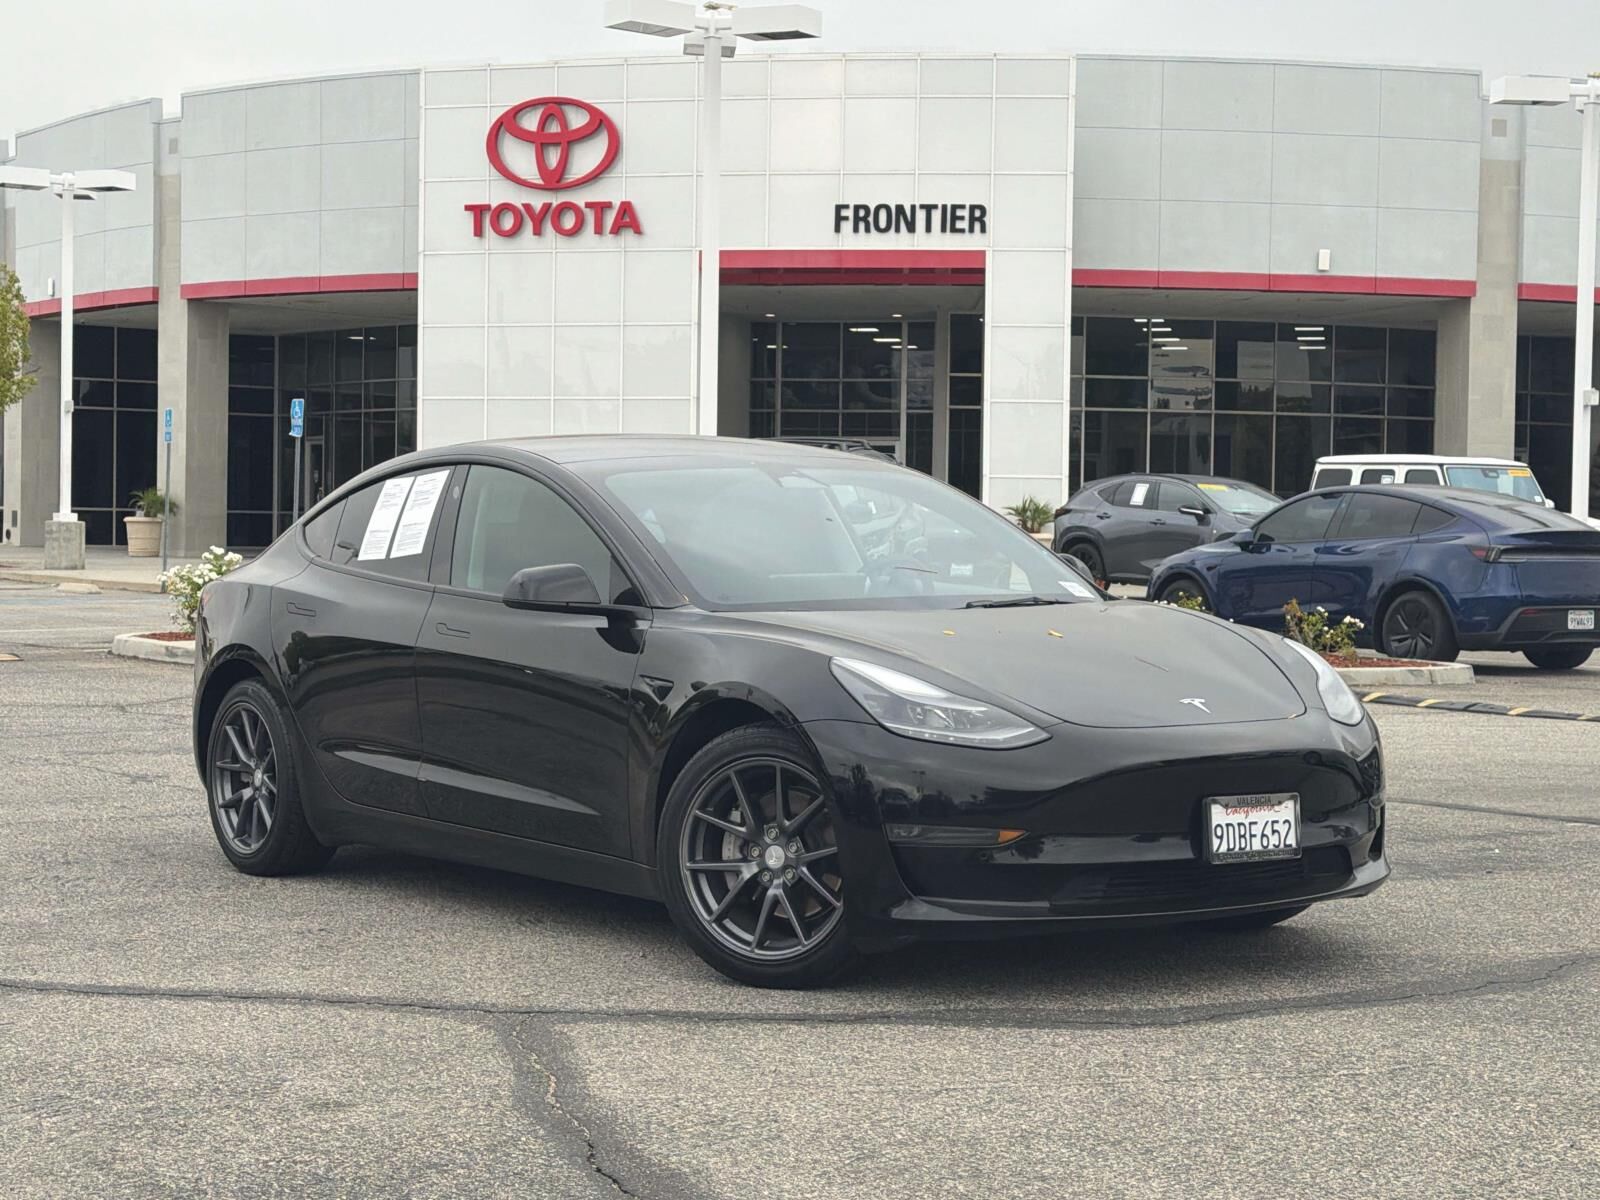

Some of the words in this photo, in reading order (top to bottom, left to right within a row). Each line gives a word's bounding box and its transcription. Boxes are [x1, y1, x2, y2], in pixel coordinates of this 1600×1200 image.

[464, 200, 642, 238] TOYOTA
[834, 203, 987, 234] FRONTIER
[1237, 796, 1272, 805] VALENCIA
[1213, 819, 1293, 853] 9DBF652
